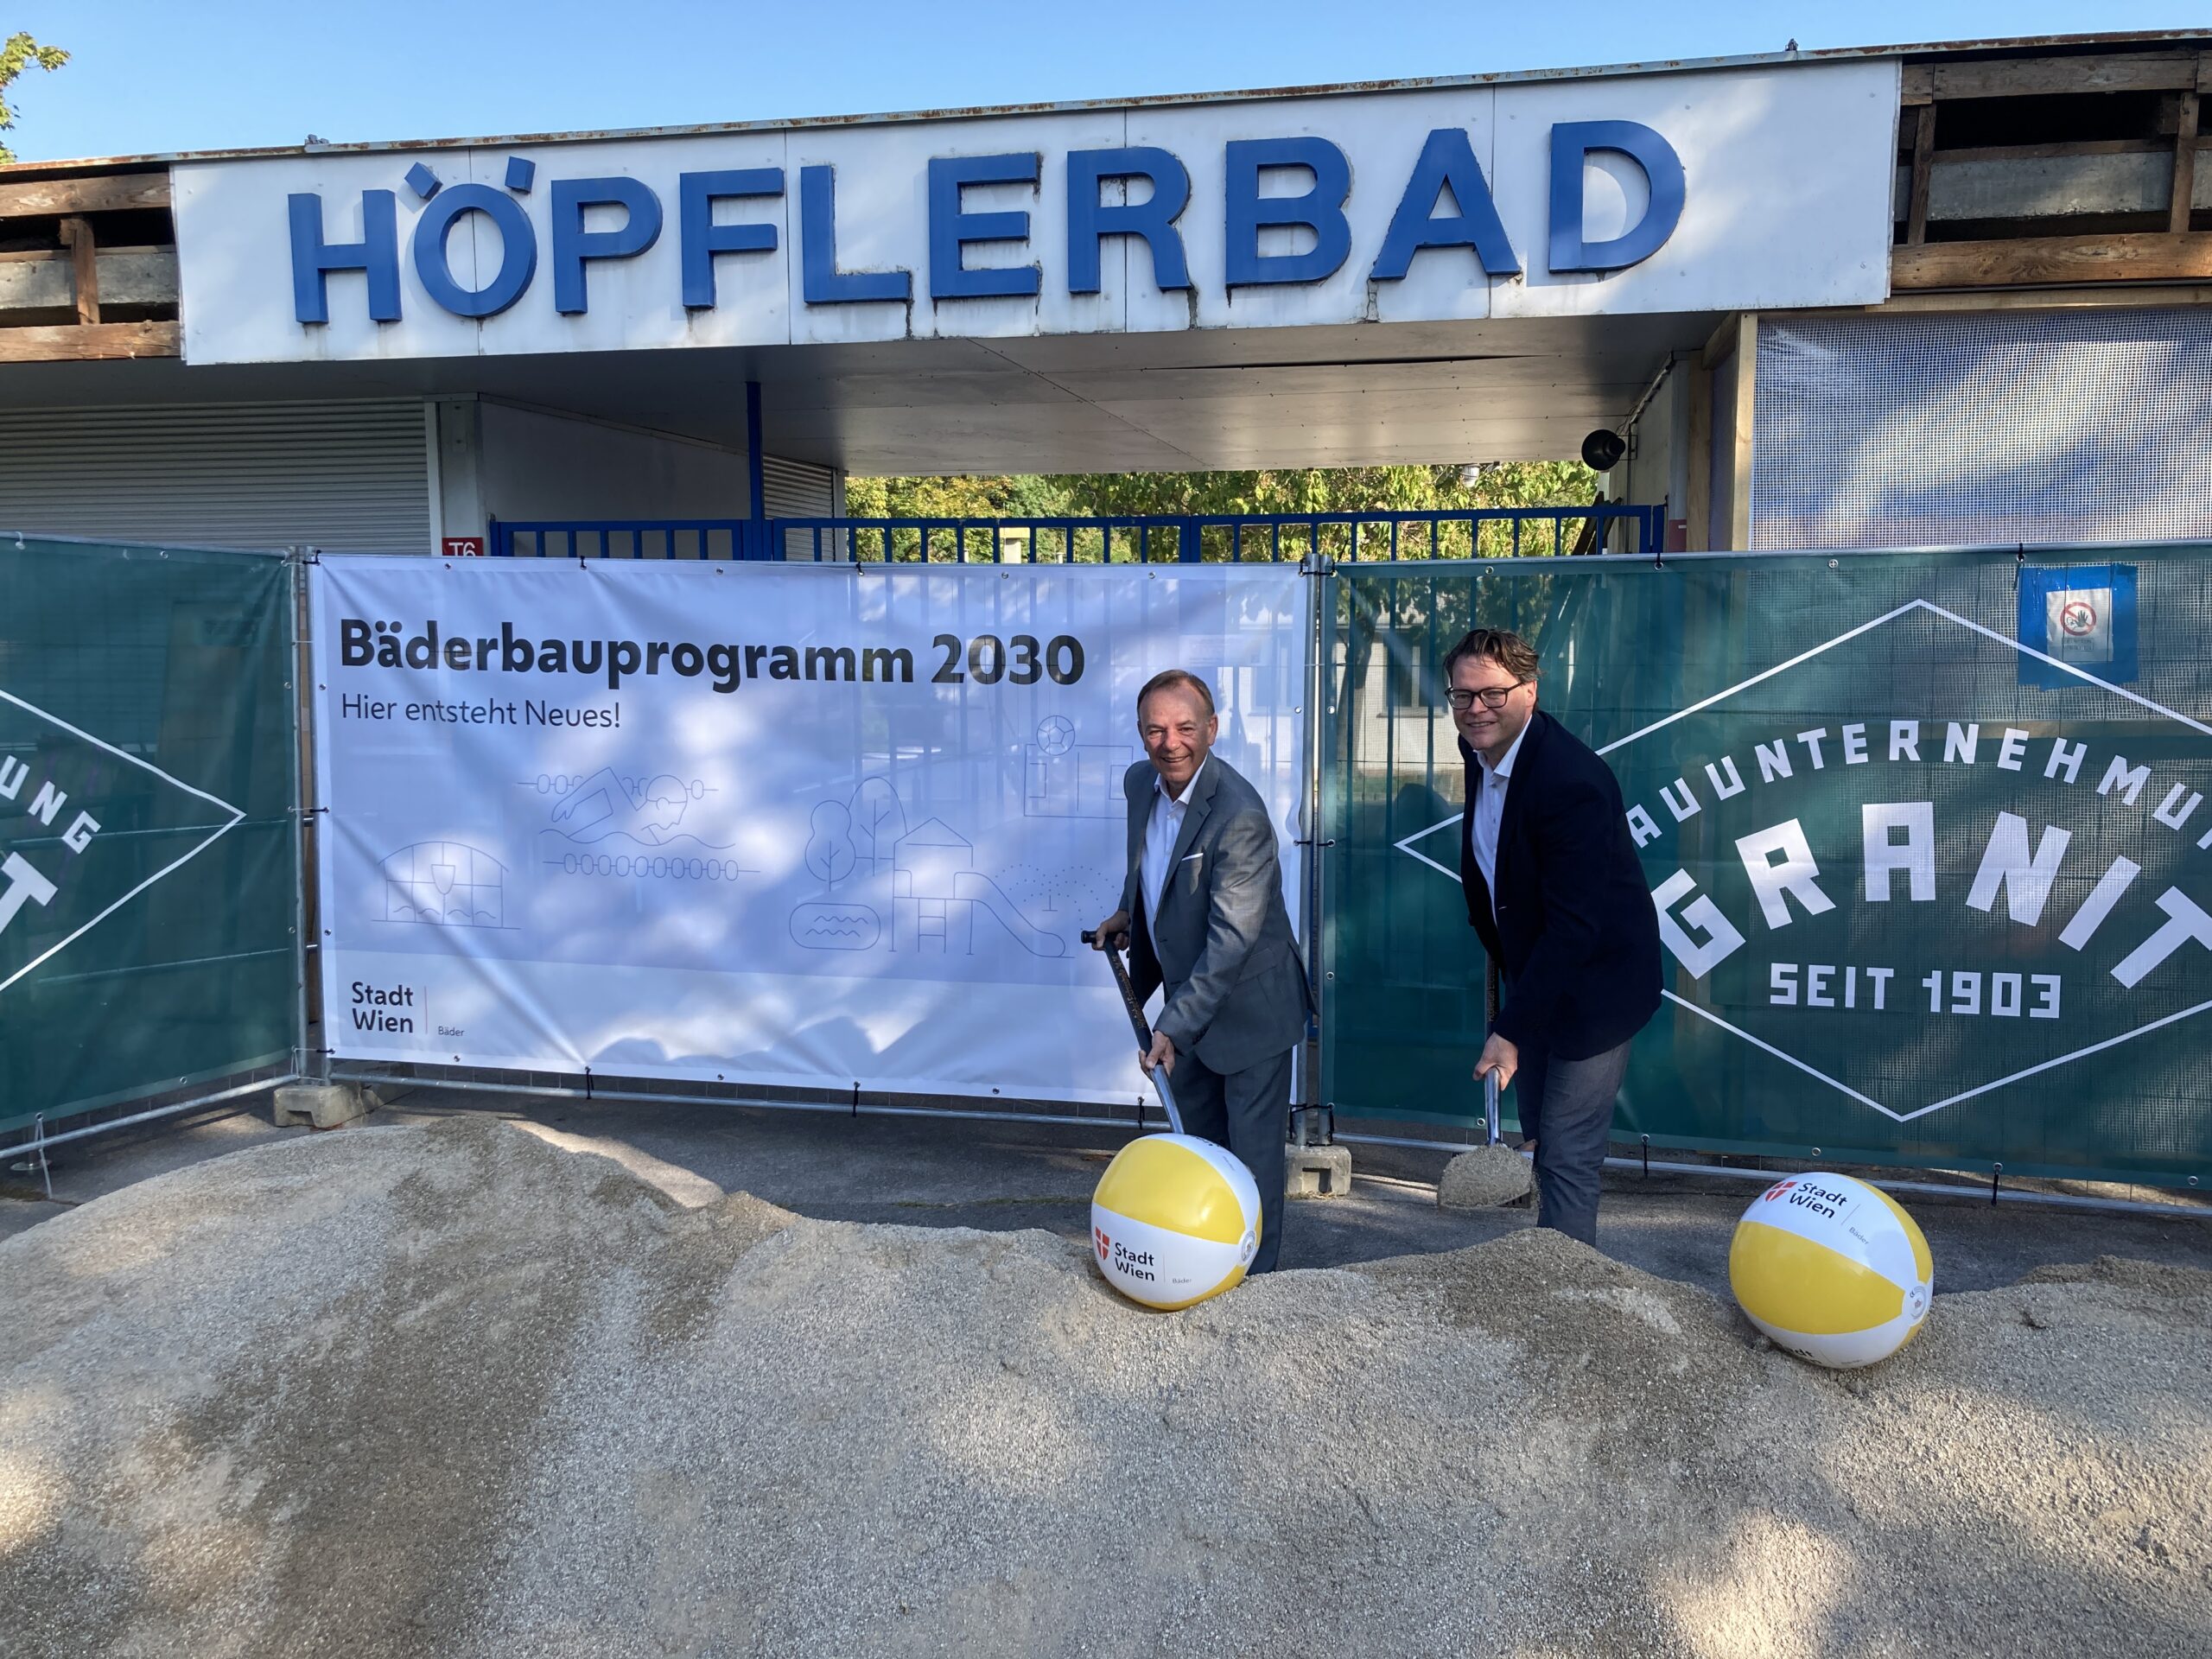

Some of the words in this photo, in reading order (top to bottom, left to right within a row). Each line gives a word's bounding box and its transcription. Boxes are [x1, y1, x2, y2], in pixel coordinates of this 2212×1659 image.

[288, 119, 1687, 324] HÖPFLERBAD
[448, 542, 476, 556] T6
[340, 619, 914, 694] Bäderbauprogramm
[931, 633, 1085, 685] 2030
[342, 693, 397, 721] Hier
[404, 698, 518, 725] entsteht
[525, 700, 620, 728] Neues!
[1626, 720, 2212, 848] AUUNTERNEHMU
[1650, 801, 2212, 989] GRANIT
[352, 981, 414, 1007] Stadt
[1770, 963, 1895, 1010] SEIT
[1922, 969, 2062, 1019] 1903
[352, 1007, 414, 1033] Wien
[438, 1026, 465, 1037] Bäder
[1789, 1192, 1835, 1219] Wien
[1797, 1182, 1847, 1206] Stadt
[1115, 1242, 1155, 1267] Stadt
[1115, 1257, 1155, 1281] Wien
